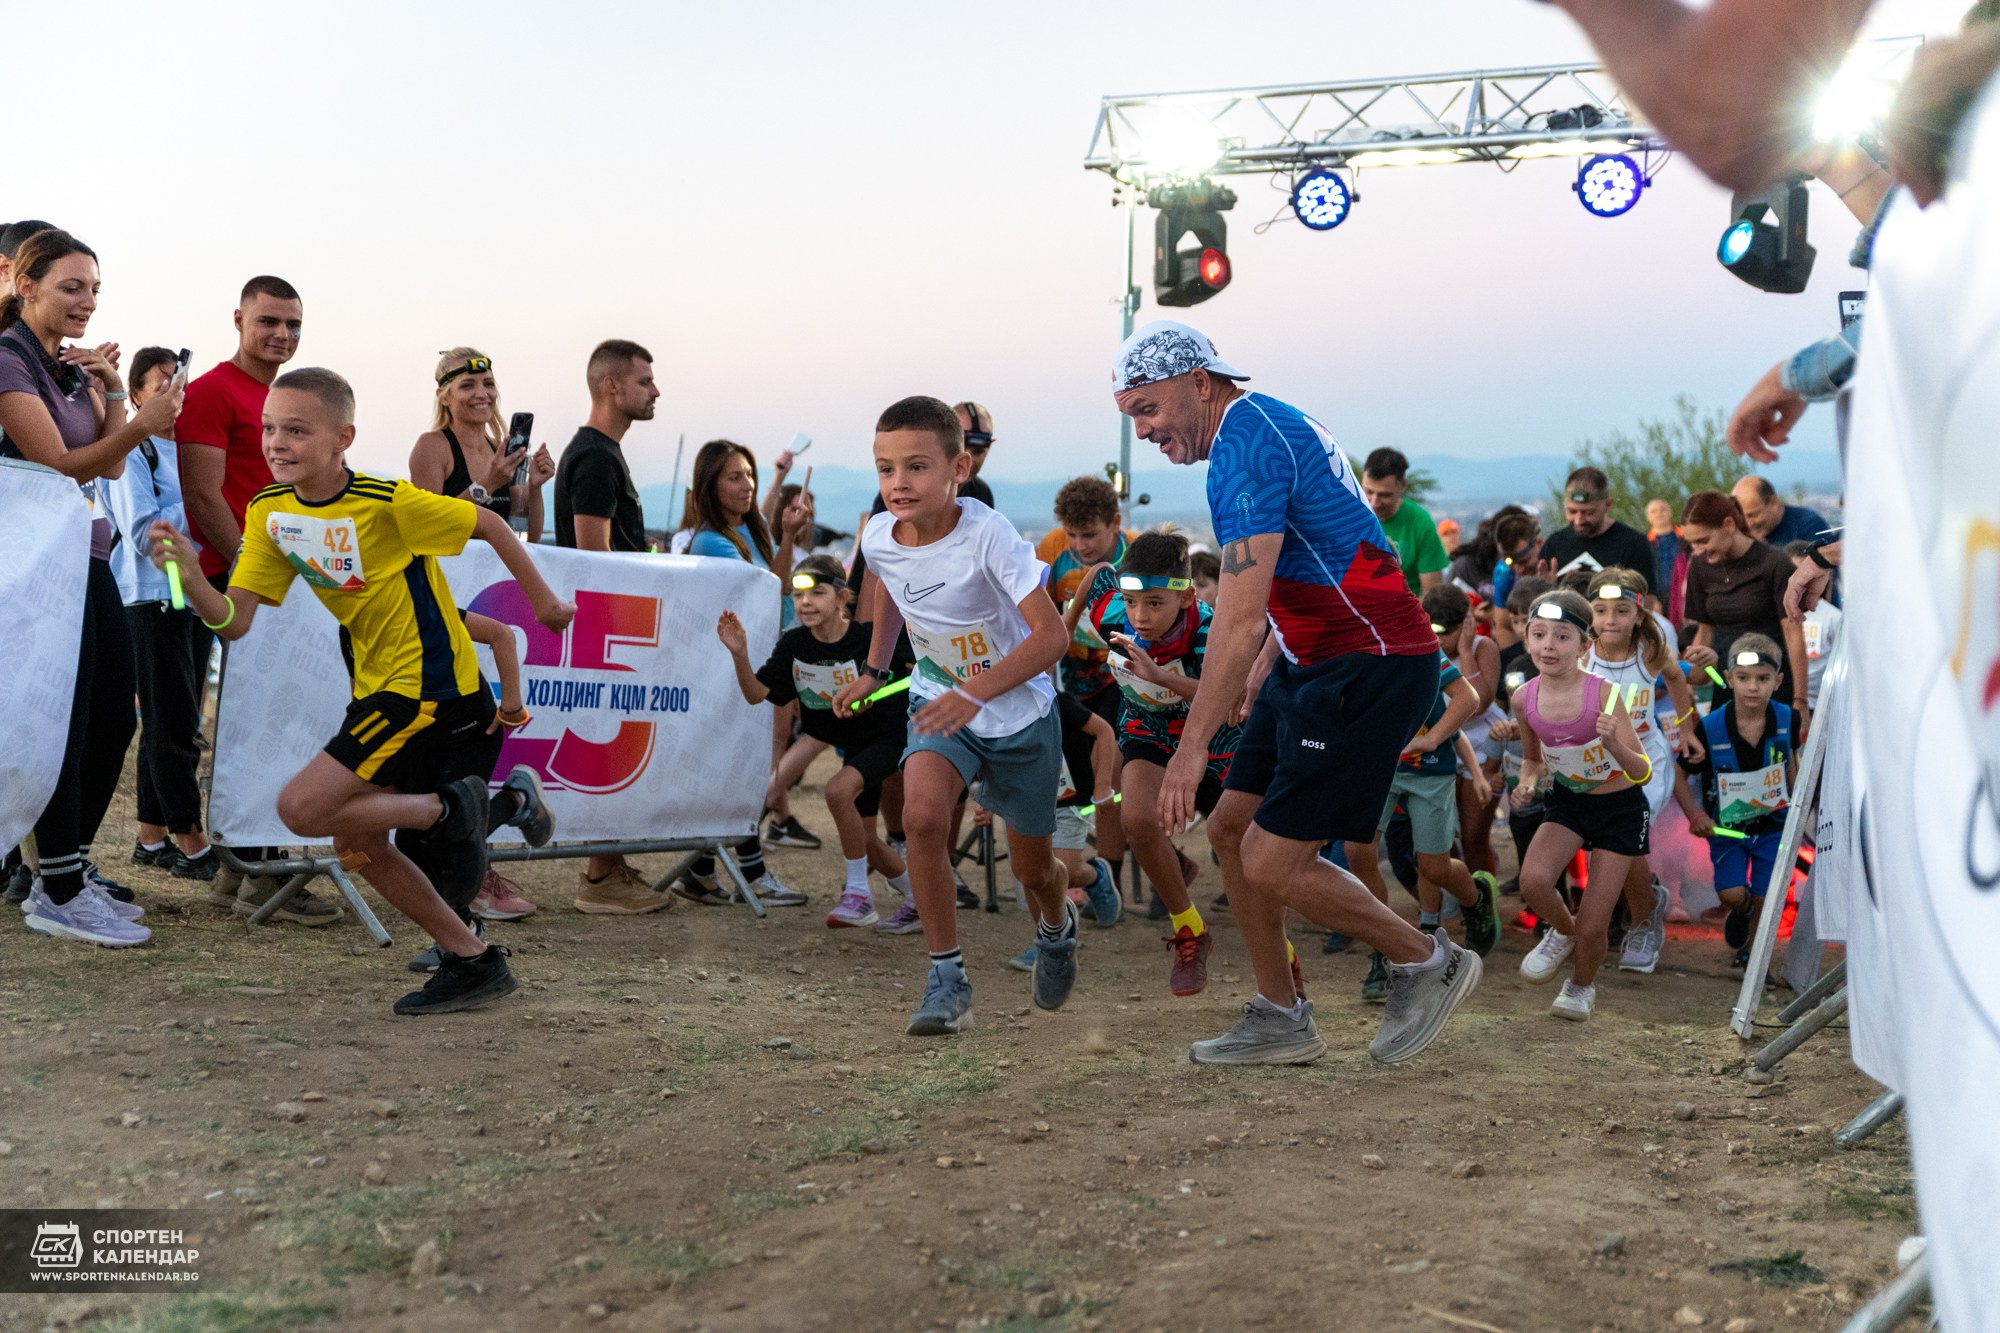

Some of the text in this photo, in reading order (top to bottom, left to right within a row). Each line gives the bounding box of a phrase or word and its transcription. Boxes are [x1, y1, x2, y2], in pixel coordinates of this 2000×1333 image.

[324, 527, 352, 552] 42
[322, 558, 352, 571] KIDS
[298, 622, 343, 660] PLOV
[950, 632, 988, 661] 78
[832, 667, 855, 686] 56
[956, 659, 991, 678] KIDS
[526, 679, 605, 712] ХОЛДИНГ
[610, 683, 647, 714] КЦМ
[650, 685, 689, 713] 2000
[1156, 690, 1177, 700] KID
[1301, 739, 1326, 750] BOSS
[1584, 744, 1605, 764] 47
[1584, 761, 1610, 778] KIDS
[1763, 768, 1782, 787] 48
[1761, 788, 1782, 801] KIDS
[1441, 949, 1463, 987] HOKA
